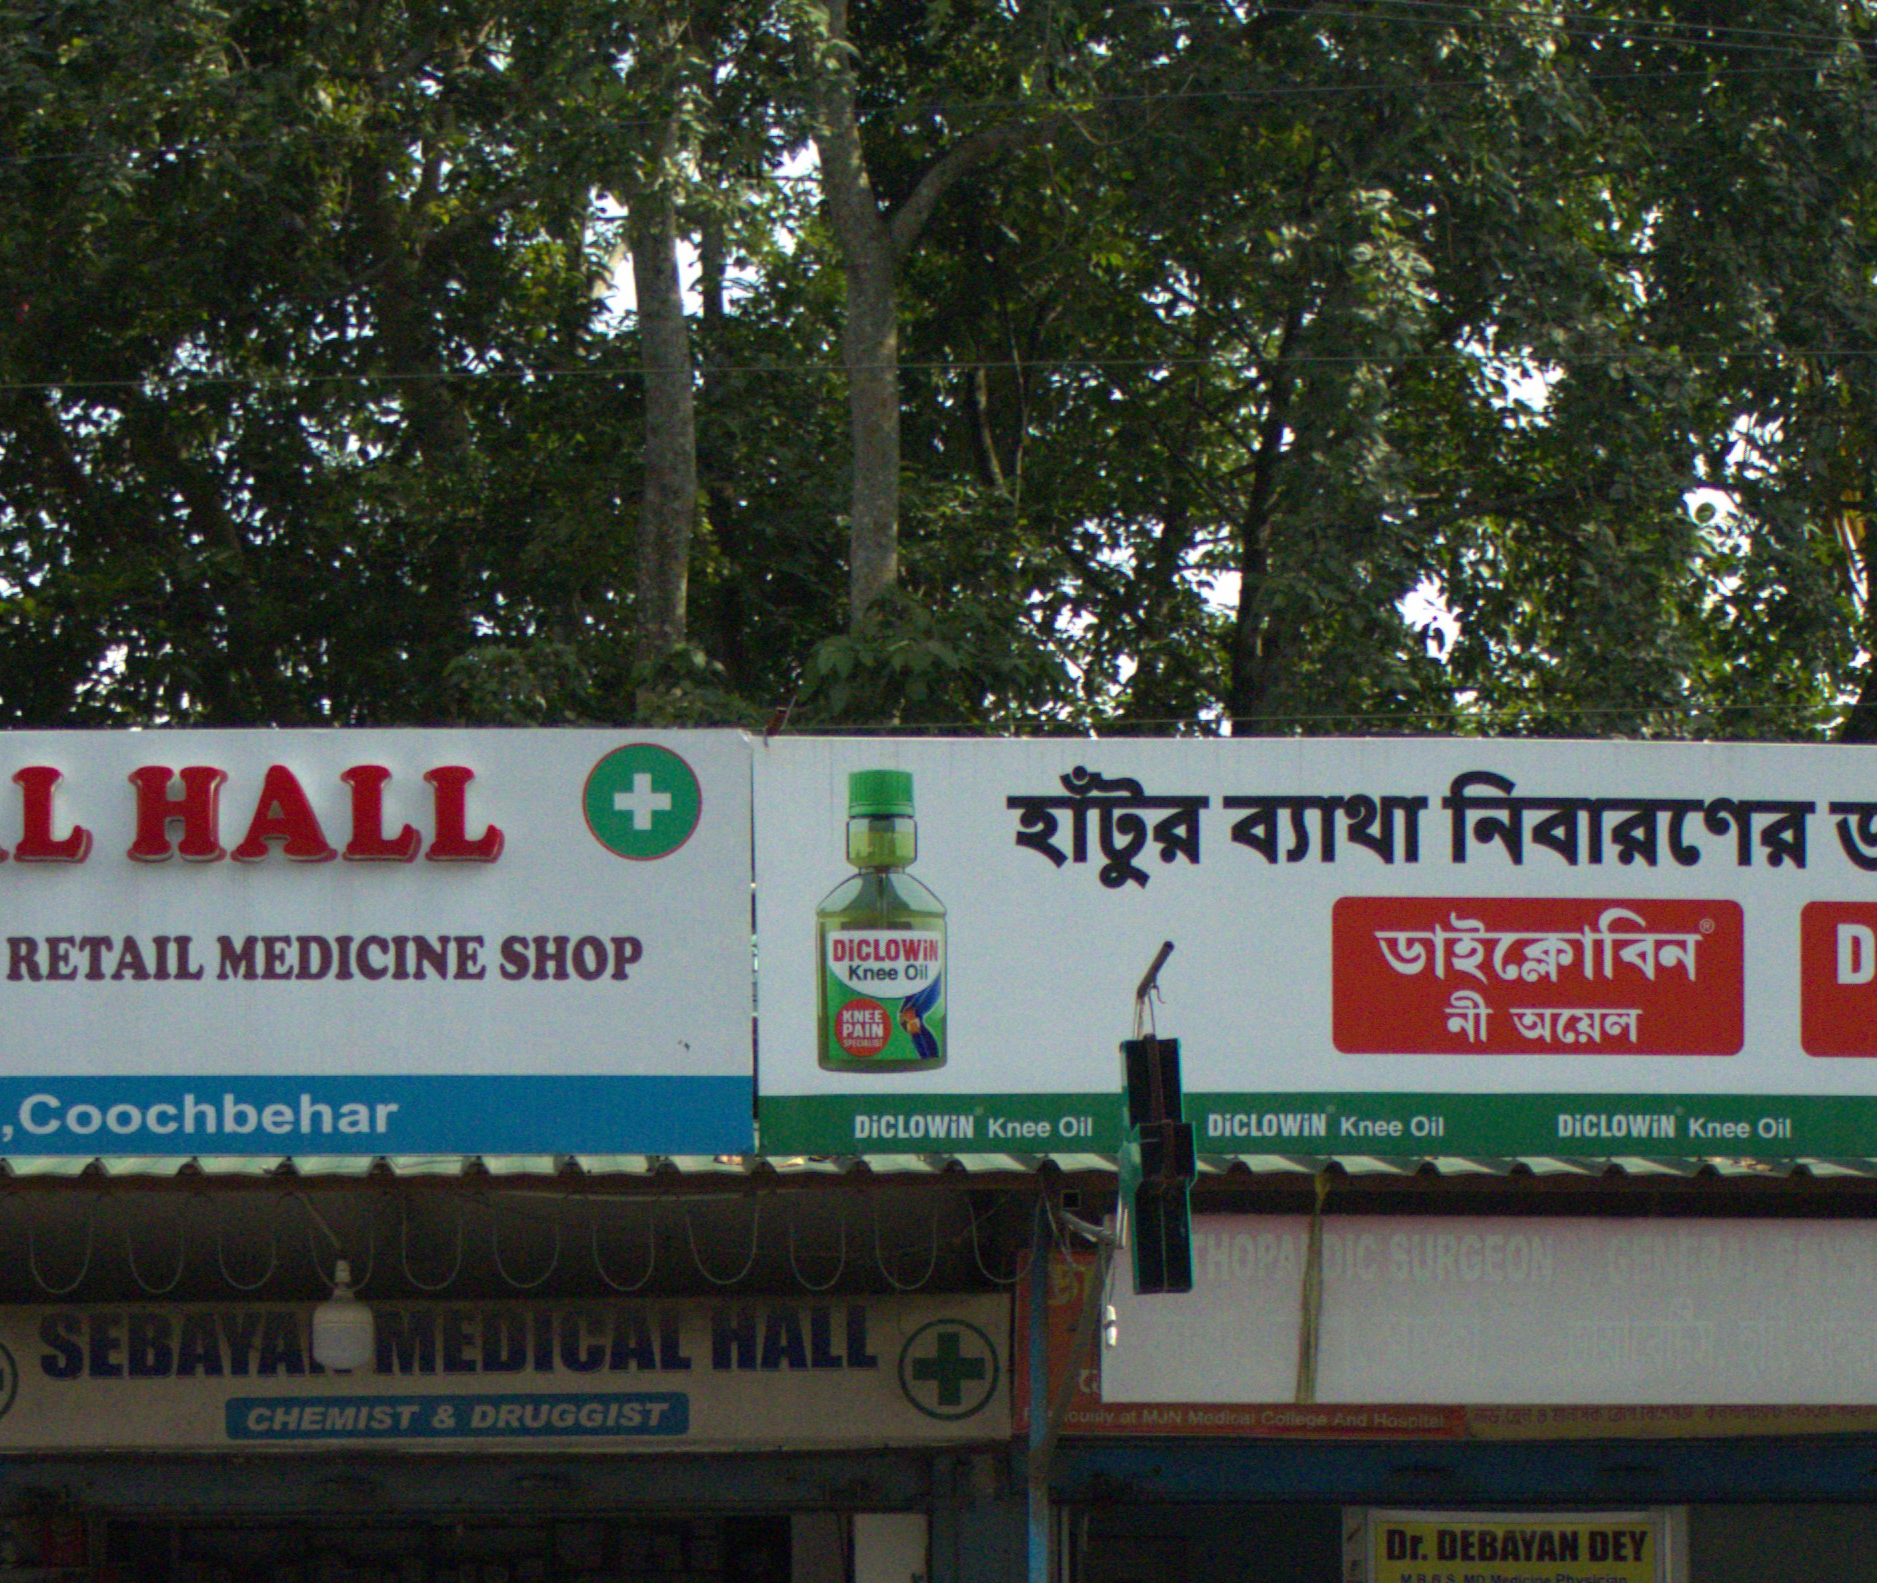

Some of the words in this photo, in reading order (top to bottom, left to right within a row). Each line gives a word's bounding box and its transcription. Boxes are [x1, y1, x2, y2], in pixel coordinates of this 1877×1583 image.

[127, 764, 505, 864] HALL
[1007, 765, 1208, 888] হাঁটুর
[1224, 794, 1427, 865] ব্যাথা
[1443, 771, 1815, 868] নিবারণের
[6, 936, 203, 981] RETAIL
[216, 934, 489, 982] MEDICINE
[500, 934, 644, 982] SHOP
[1375, 907, 1701, 984] ডাইক্লোবিন
[848, 964, 899, 981] Knee
[904, 963, 928, 980] Oil
[842, 1009, 884, 1022] KNEE
[842, 1023, 884, 1038] PAIN
[1444, 998, 1489, 1044] নী
[1511, 1006, 1641, 1046] অয়েল
[987, 1116, 1052, 1141] Knee
[1058, 1115, 1093, 1141] Oil
[1339, 1115, 1402, 1139] Knee
[1409, 1114, 1445, 1139] Oil
[1688, 1116, 1751, 1140] Knee
[1757, 1116, 1792, 1140] Oil
[1389, 1233, 1554, 1283] SURGEON
[374, 1305, 693, 1377] MEDICAL
[711, 1305, 878, 1373] HALL
[246, 1405, 419, 1433] CHEMIST
[430, 1405, 455, 1432] &
[469, 1402, 670, 1431] DRUGGIST
[1187, 1408, 1256, 1427] Medical
[1260, 1411, 1325, 1430] College
[1332, 1411, 1367, 1428] And
[1373, 1412, 1445, 1432] Hospital
[1387, 1529, 1428, 1562] Dr.
[1437, 1529, 1579, 1562] DEBAYAN
[1588, 1529, 1648, 1562] DEY
